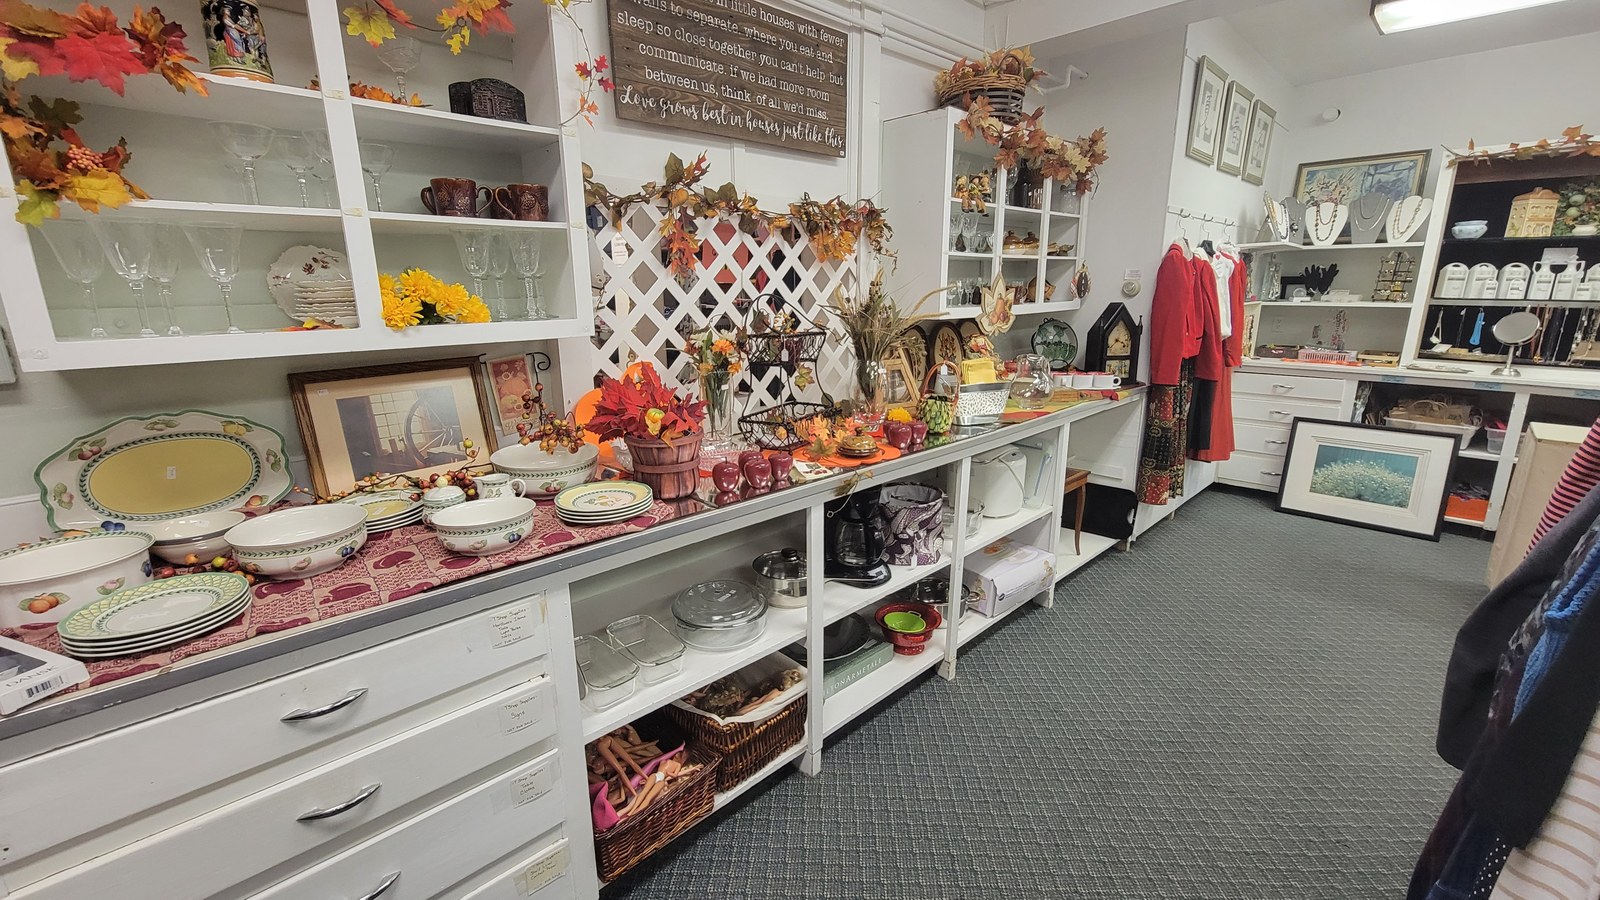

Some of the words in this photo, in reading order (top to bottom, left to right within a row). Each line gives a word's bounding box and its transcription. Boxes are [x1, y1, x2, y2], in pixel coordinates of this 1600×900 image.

[617, 11, 653, 35] sleep
[656, 24, 671, 37] so
[674, 28, 706, 47] close
[708, 36, 757, 61] together
[758, 52, 779, 68] you
[780, 60, 804, 75] can't
[805, 65, 826, 82] help
[828, 72, 844, 86] but
[670, 2, 683, 17] to
[744, 26, 777, 46] where
[778, 38, 798, 53] you
[799, 45, 815, 59] eat
[816, 50, 834, 64] and
[730, 0, 757, 18] little
[759, 8, 795, 31] houses
[797, 22, 819, 39] with
[819, 29, 845, 47] fewer
[638, 43, 727, 76] communicate.
[729, 64, 739, 78] if
[740, 69, 756, 83] we
[757, 72, 777, 88] had
[779, 80, 805, 95] more
[806, 87, 830, 102] room
[644, 65, 699, 91] between
[700, 82, 719, 98] us,
[721, 84, 752, 103] think
[756, 94, 767, 106] of
[768, 97, 781, 110] all
[783, 101, 804, 115] we'd
[806, 107, 829, 121] miss.
[620, 84, 657, 109] Love
[659, 97, 700, 120] grows
[702, 101, 730, 125] best
[730, 112, 744, 128] in
[746, 109, 780, 137] houses
[781, 121, 805, 142] just
[805, 122, 823, 144] like
